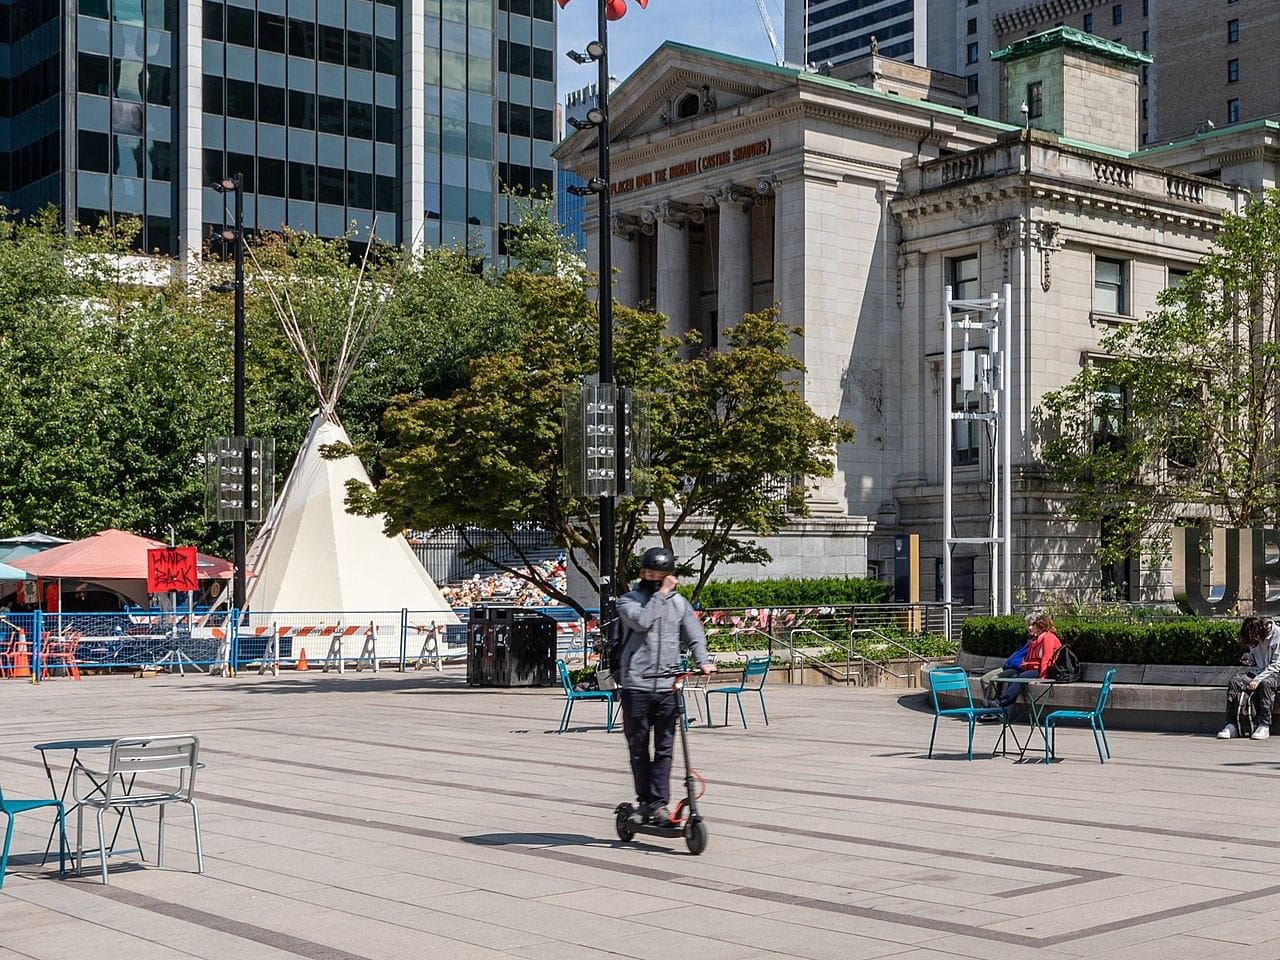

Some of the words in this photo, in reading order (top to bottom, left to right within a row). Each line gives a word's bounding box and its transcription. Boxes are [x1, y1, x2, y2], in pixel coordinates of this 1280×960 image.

[655, 168, 667, 183] THE
[152, 551, 188, 566] LAND
[155, 565, 195, 588] BACK
